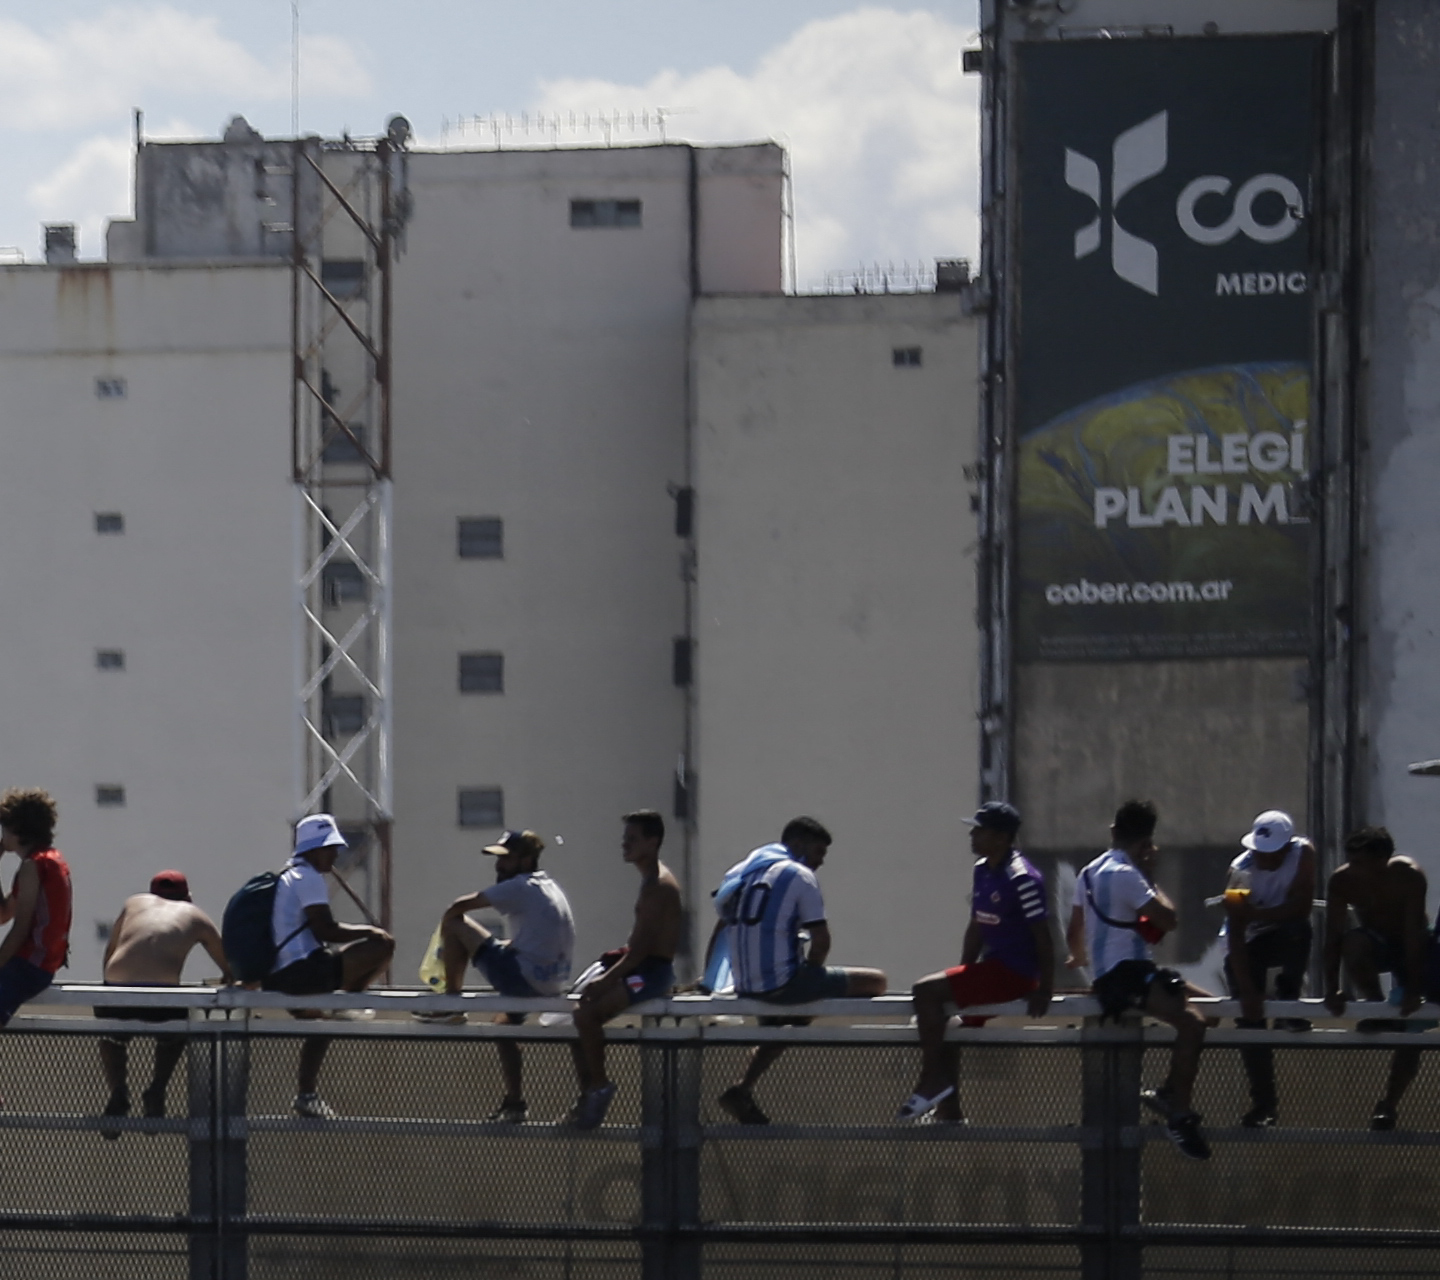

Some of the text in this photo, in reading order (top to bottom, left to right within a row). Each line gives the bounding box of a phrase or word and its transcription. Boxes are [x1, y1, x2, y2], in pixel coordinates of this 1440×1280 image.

[1176, 173, 1312, 245] CO
[1216, 272, 1306, 296] MEDIC
[1167, 419, 1307, 474] ELEGÍ
[1094, 481, 1311, 528] PLAN M
[1045, 578, 1233, 605] cober.com.ar
